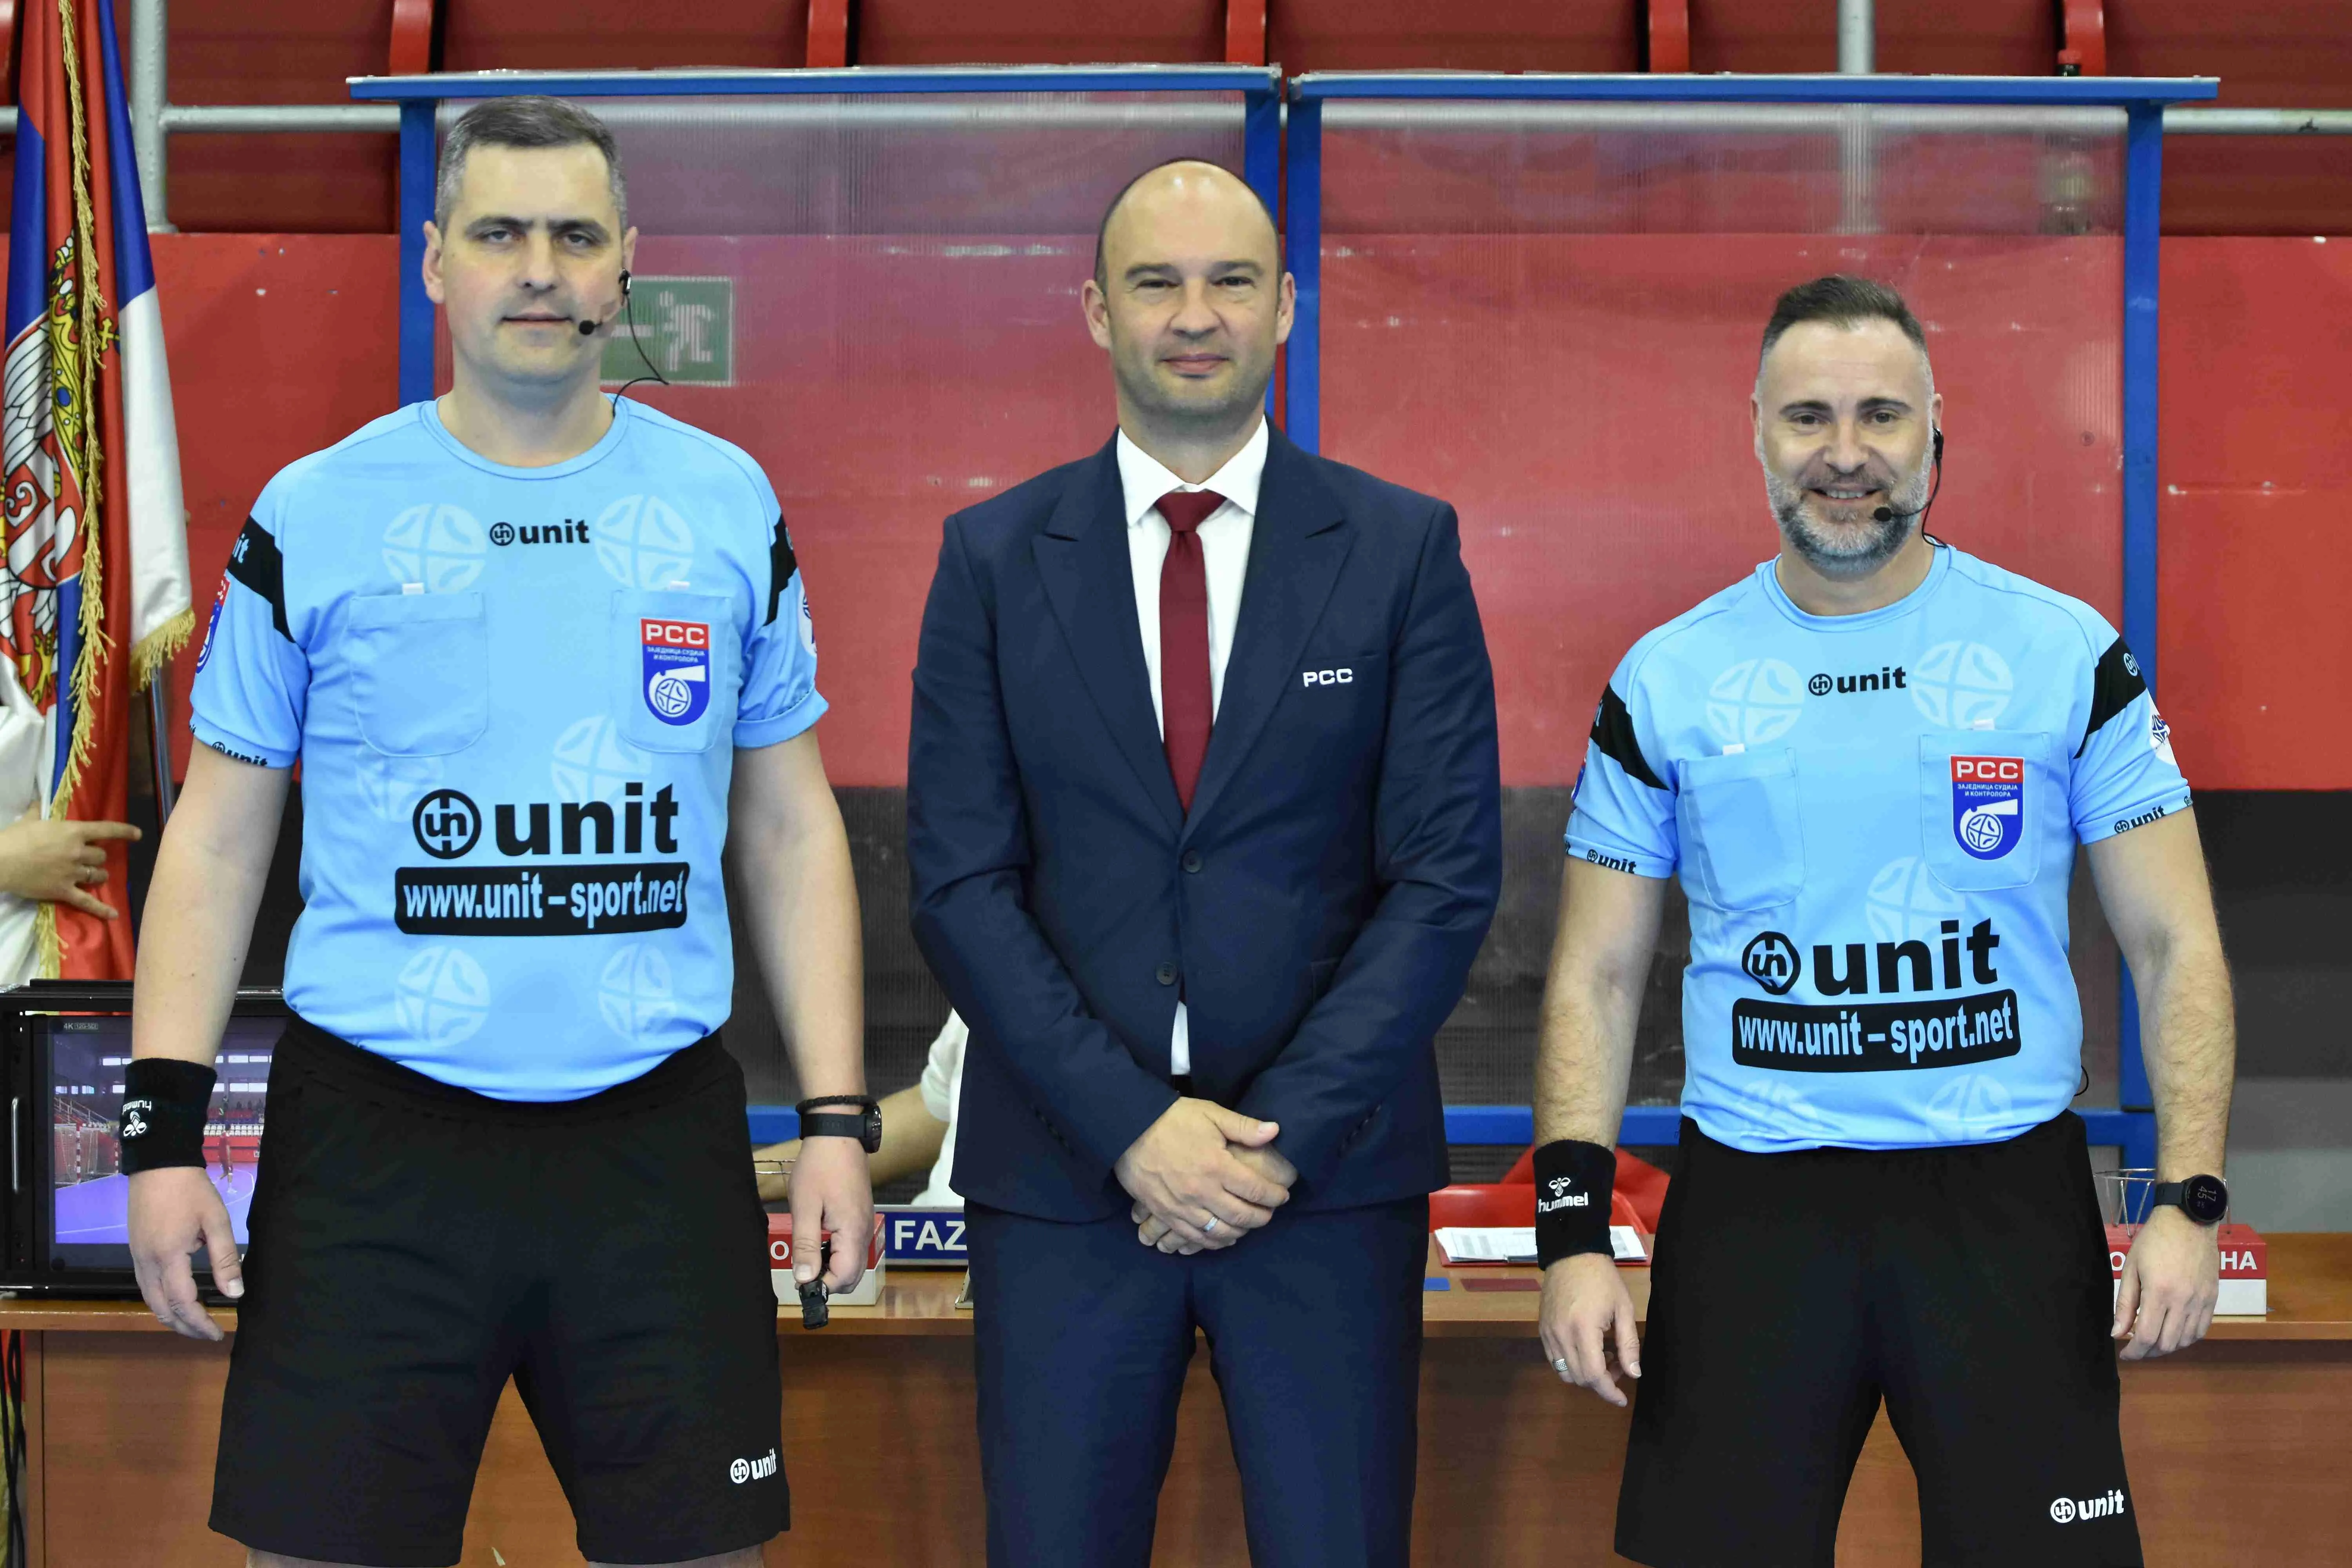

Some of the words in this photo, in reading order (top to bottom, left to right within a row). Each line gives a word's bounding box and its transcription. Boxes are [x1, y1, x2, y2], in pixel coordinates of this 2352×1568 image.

[519, 519, 590, 544] unit
[646, 623, 704, 644] РСС
[1837, 666, 1906, 693] unit
[1957, 761, 2018, 779] РСС
[495, 782, 679, 856] unit
[2131, 805, 2166, 828] unit
[1598, 855, 1637, 874] unit
[404, 869, 685, 929] www.unit-sport.net
[1813, 917, 2000, 996] unit
[1739, 996, 2013, 1063] www.unit-sport.net
[1538, 1192, 1588, 1213] hummel
[2207, 1190, 2217, 1201] 17
[751, 1447, 777, 1479] unit
[2078, 1489, 2124, 1520] unit
